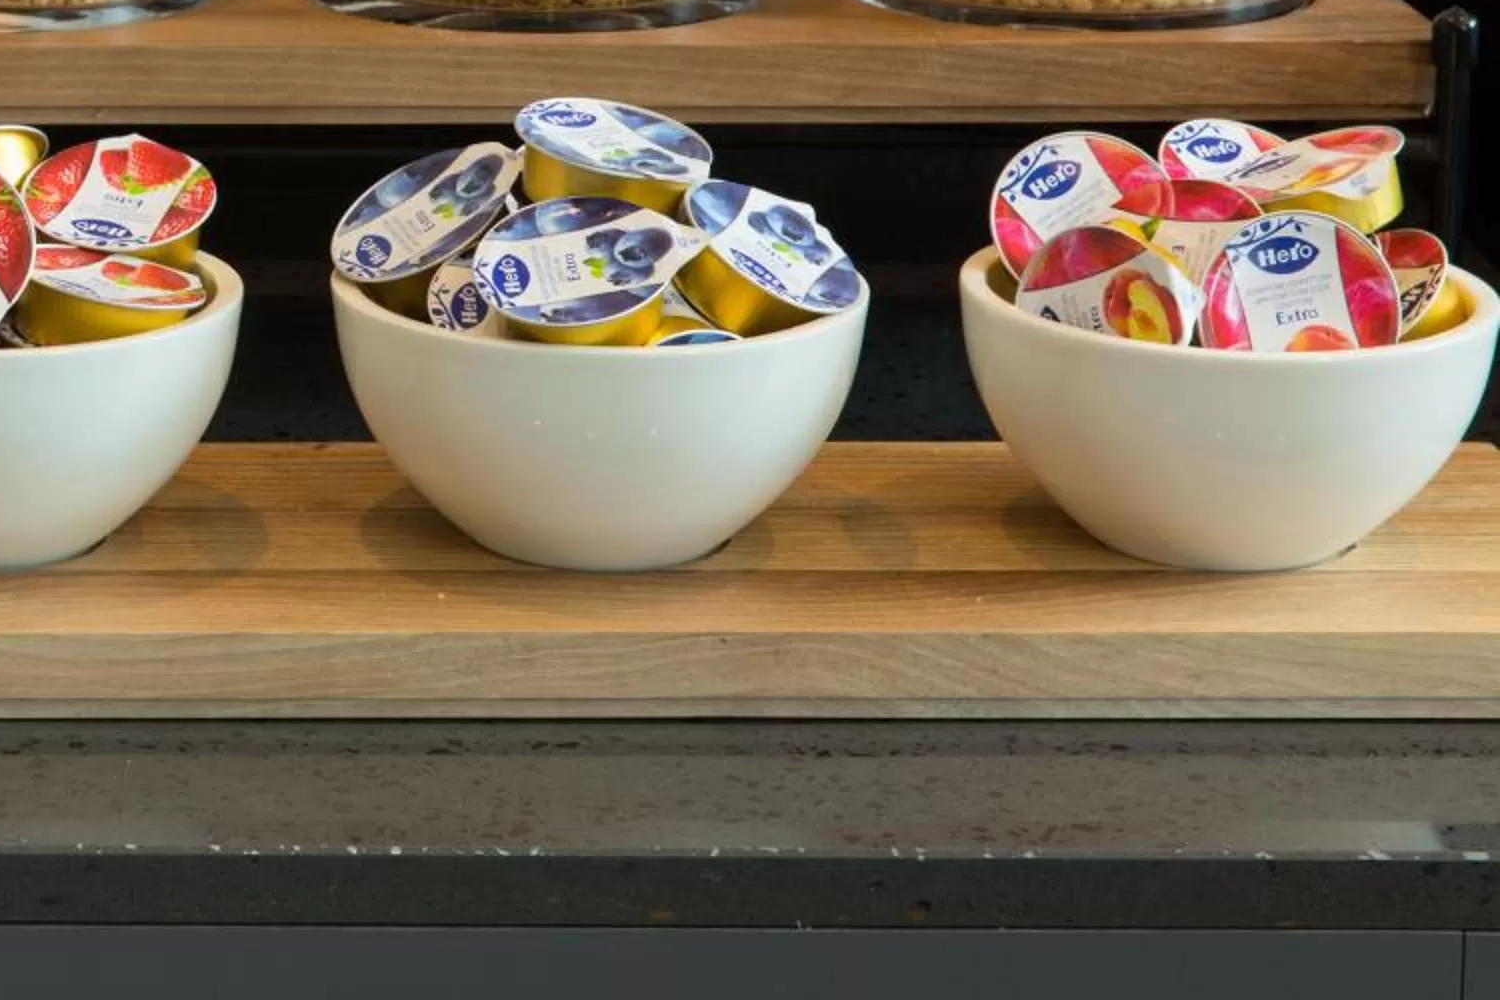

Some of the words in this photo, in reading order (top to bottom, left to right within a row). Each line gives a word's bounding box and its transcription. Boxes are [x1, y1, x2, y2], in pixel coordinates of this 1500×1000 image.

[1194, 142, 1237, 160] Hero
[1028, 163, 1076, 199] Hero
[360, 237, 389, 267] Hero
[1257, 243, 1313, 267] Hero
[498, 258, 521, 293] Hero
[565, 253, 581, 281] Extra
[458, 287, 479, 323] Hero
[1275, 308, 1319, 326] Extra
